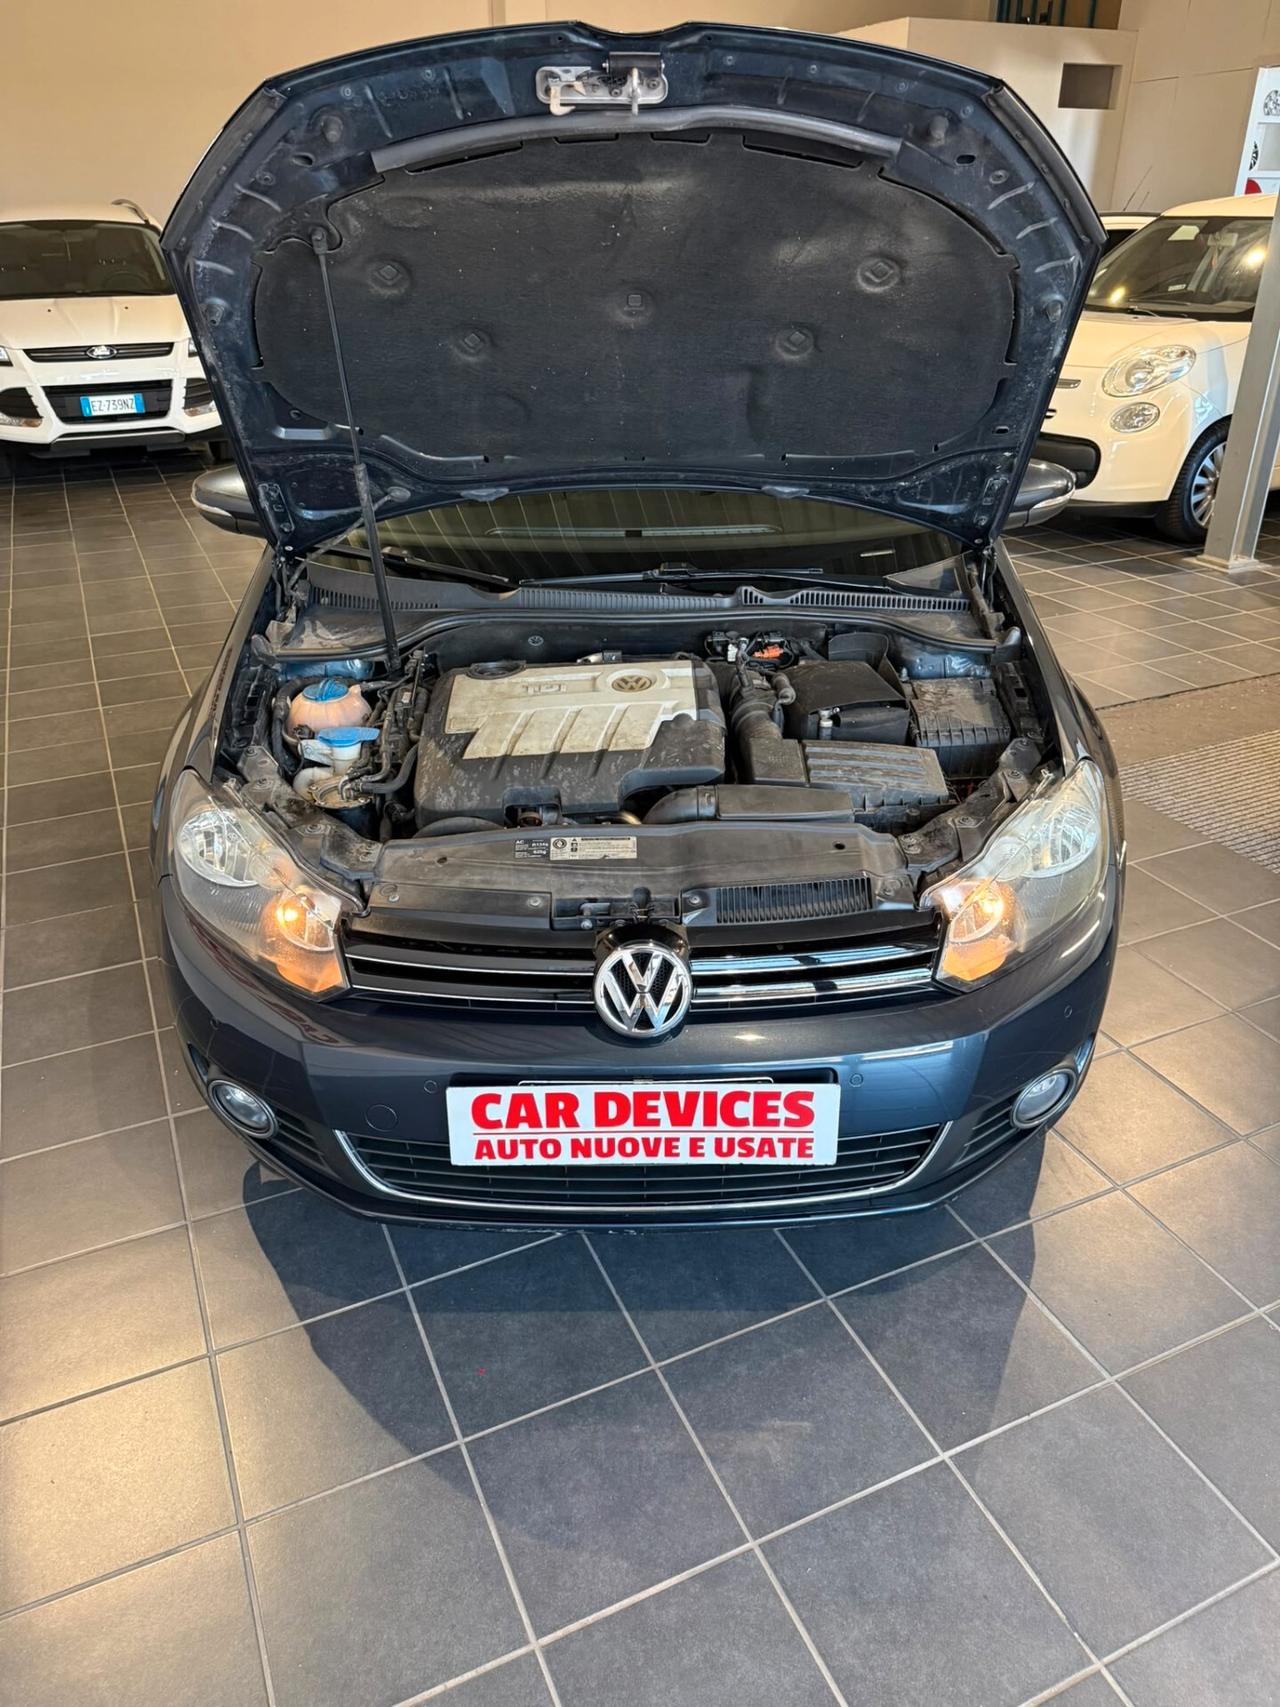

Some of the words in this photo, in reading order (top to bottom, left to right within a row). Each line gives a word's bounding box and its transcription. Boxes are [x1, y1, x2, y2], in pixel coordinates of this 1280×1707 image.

[471, 1093, 580, 1129] CAR
[594, 1091, 815, 1127] DEVICES
[475, 1138, 562, 1159] AUTO
[570, 1137, 680, 1158] NUOVE
[689, 1137, 705, 1157] E
[714, 1137, 813, 1157] USATE
